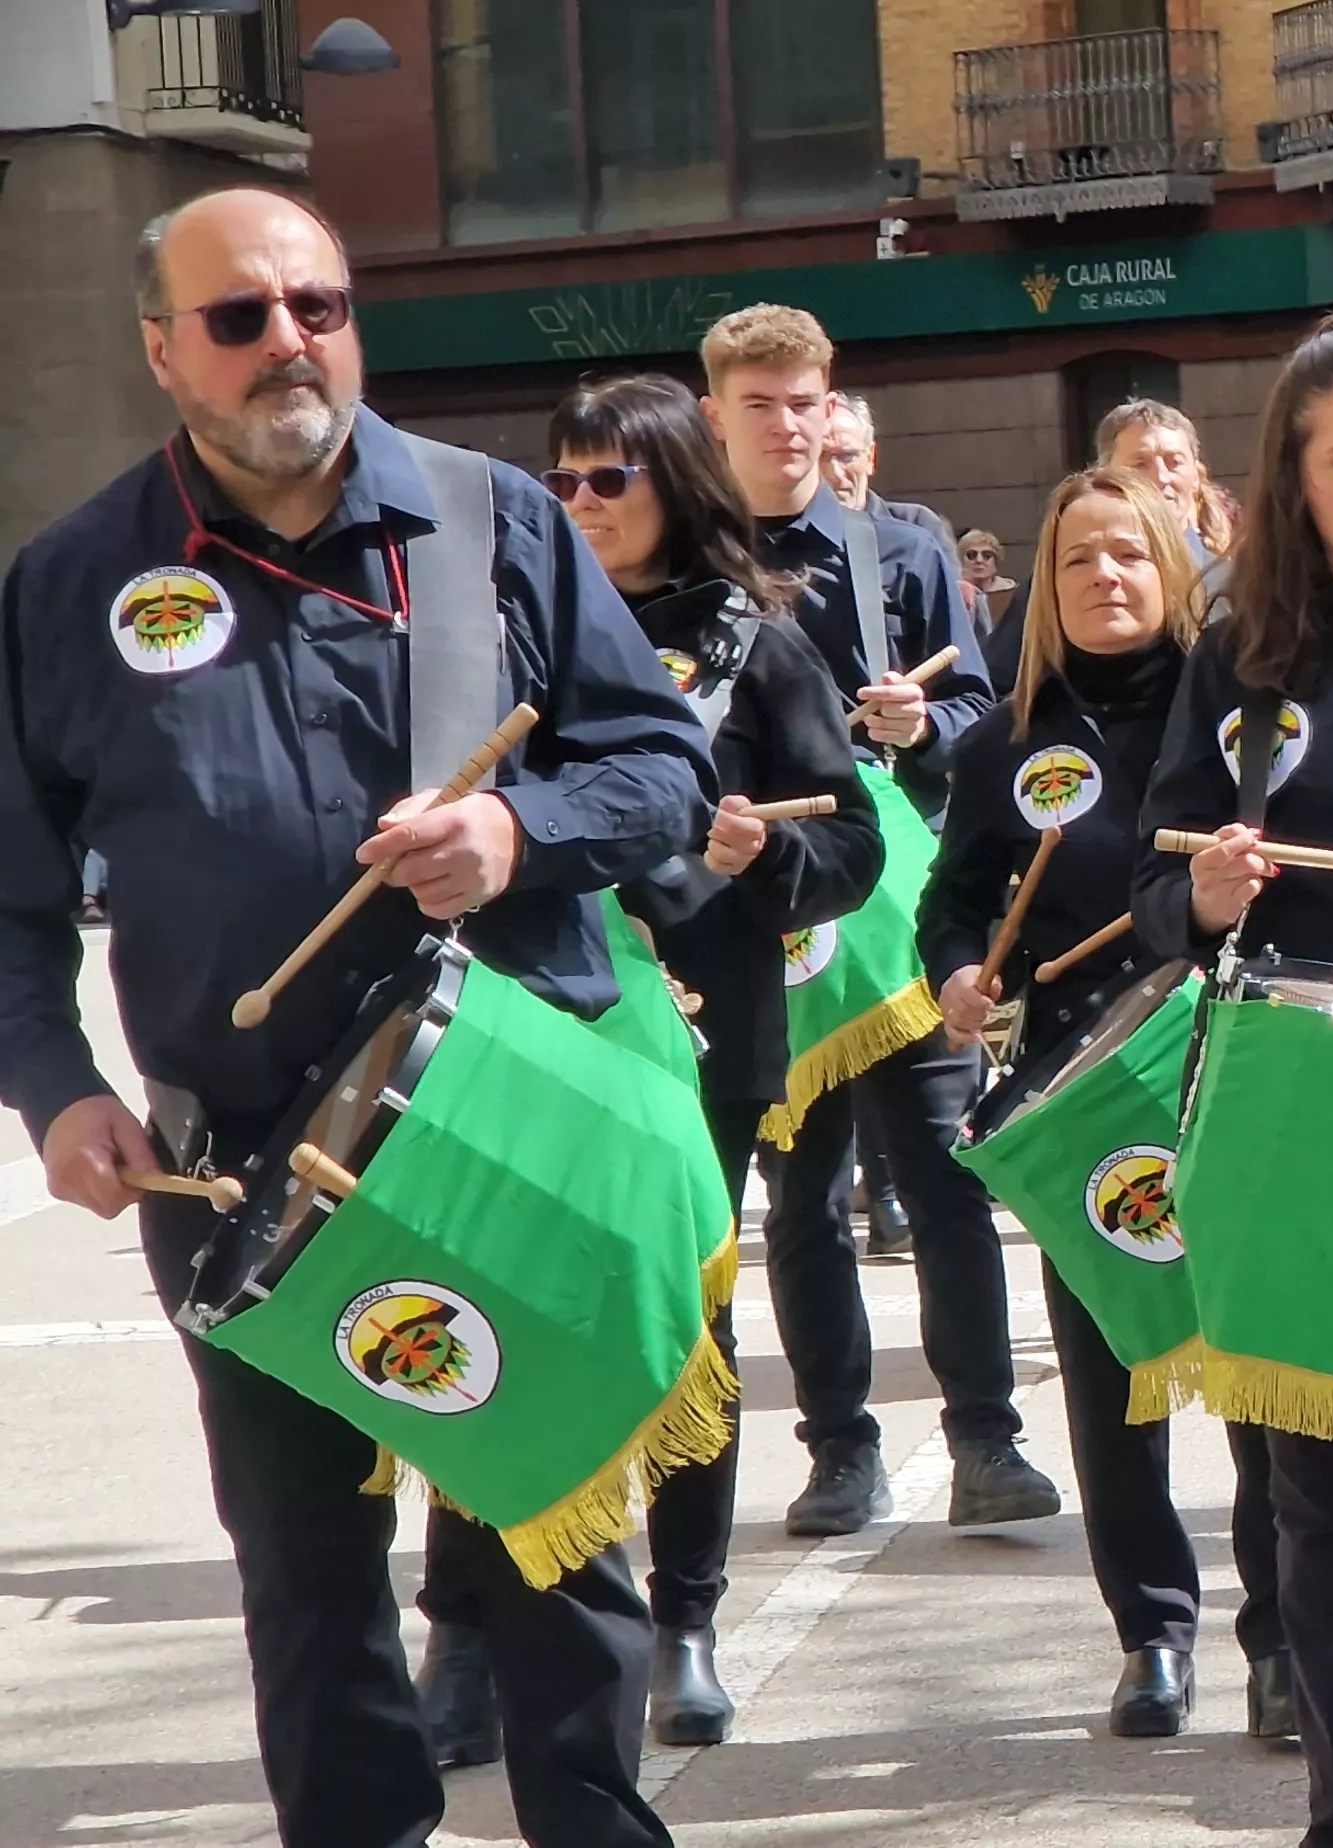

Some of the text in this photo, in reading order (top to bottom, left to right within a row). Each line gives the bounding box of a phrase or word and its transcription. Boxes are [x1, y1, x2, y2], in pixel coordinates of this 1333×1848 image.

[1066, 257, 1177, 286] CAJA RURAL
[1080, 293, 1099, 310] DE
[1088, 1148, 1135, 1191] LA TRONADA
[337, 1325, 350, 1340] LA
